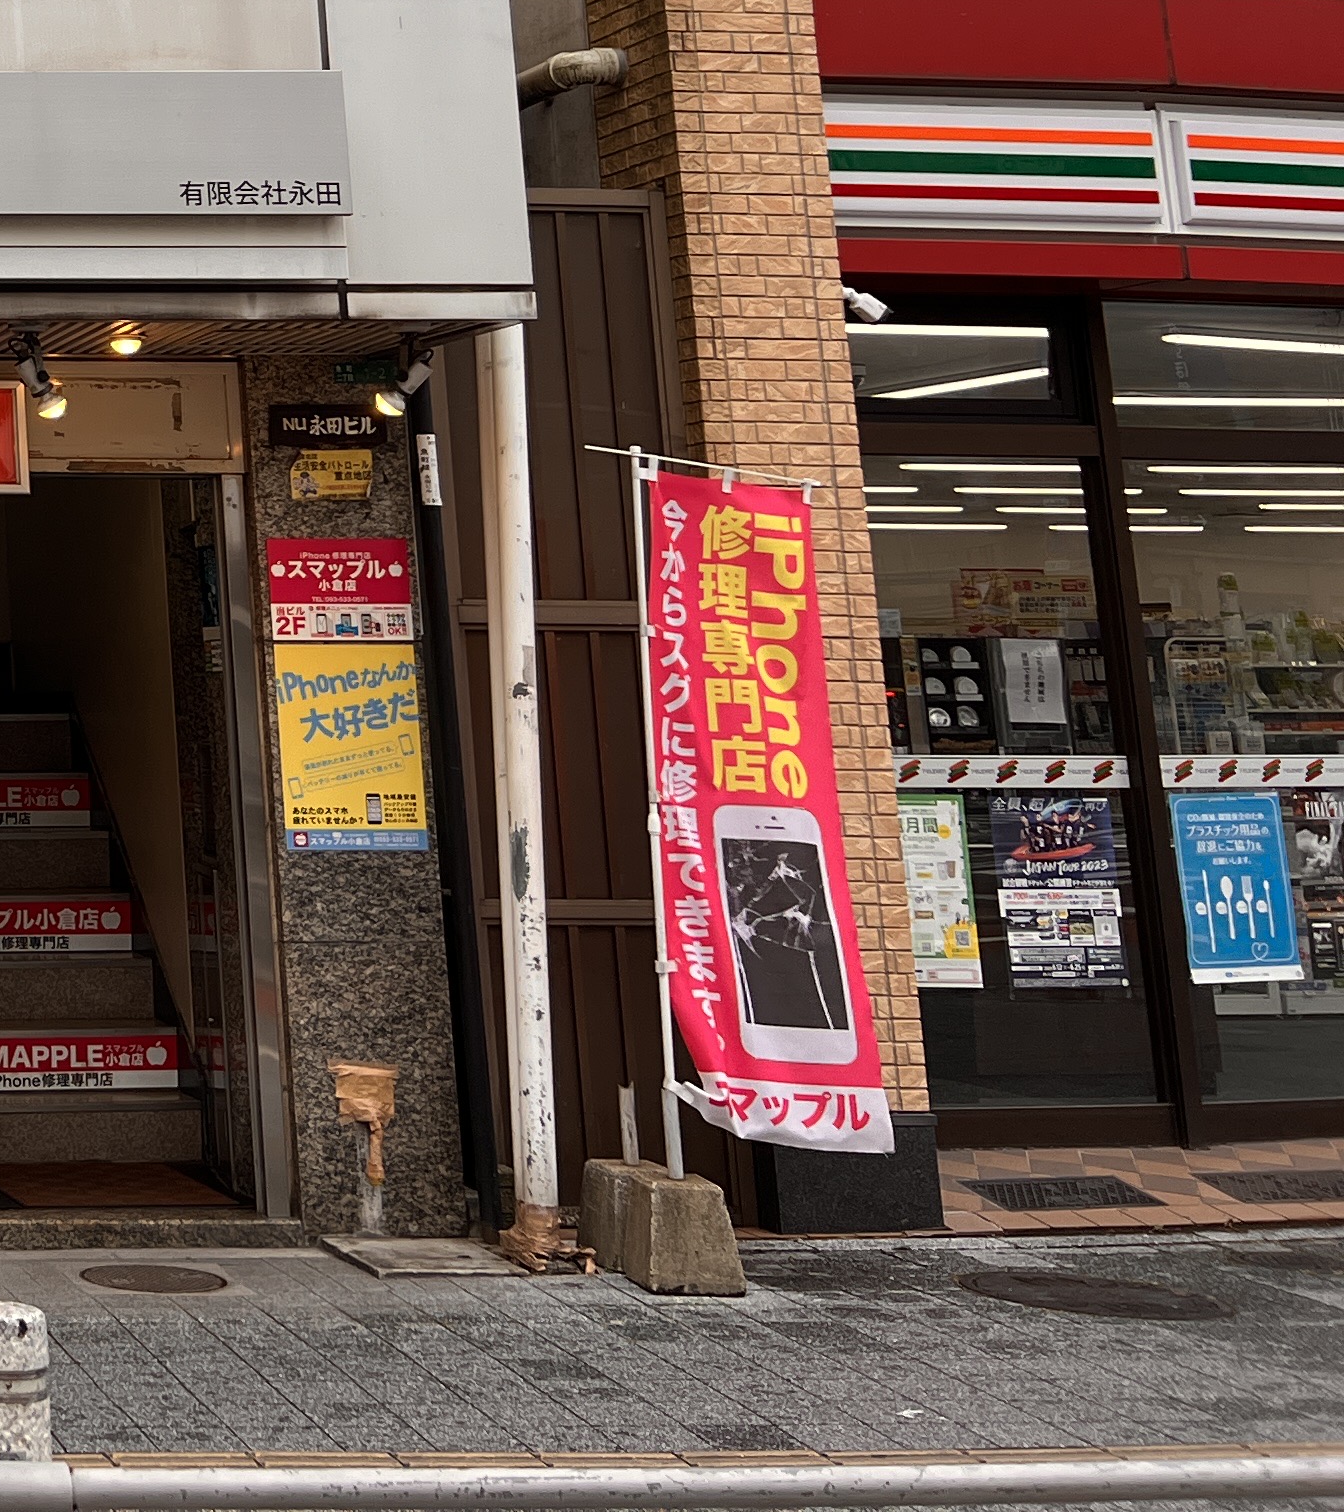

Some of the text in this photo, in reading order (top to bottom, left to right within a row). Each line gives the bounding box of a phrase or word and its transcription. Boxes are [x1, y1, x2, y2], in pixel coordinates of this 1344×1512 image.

[179, 180, 342, 206] 有限会社永田
[288, 560, 386, 579] スマップル
[319, 579, 357, 592] 小倉店
[276, 616, 306, 635] 2F
[699, 504, 769, 795] 修理専門店
[750, 510, 810, 800] iPhone
[300, 688, 420, 743] 大好きだ
[24, 794, 59, 807] 小倉店
[1081, 859, 1109, 871] 2023
[105, 1053, 144, 1068] 小倉店
